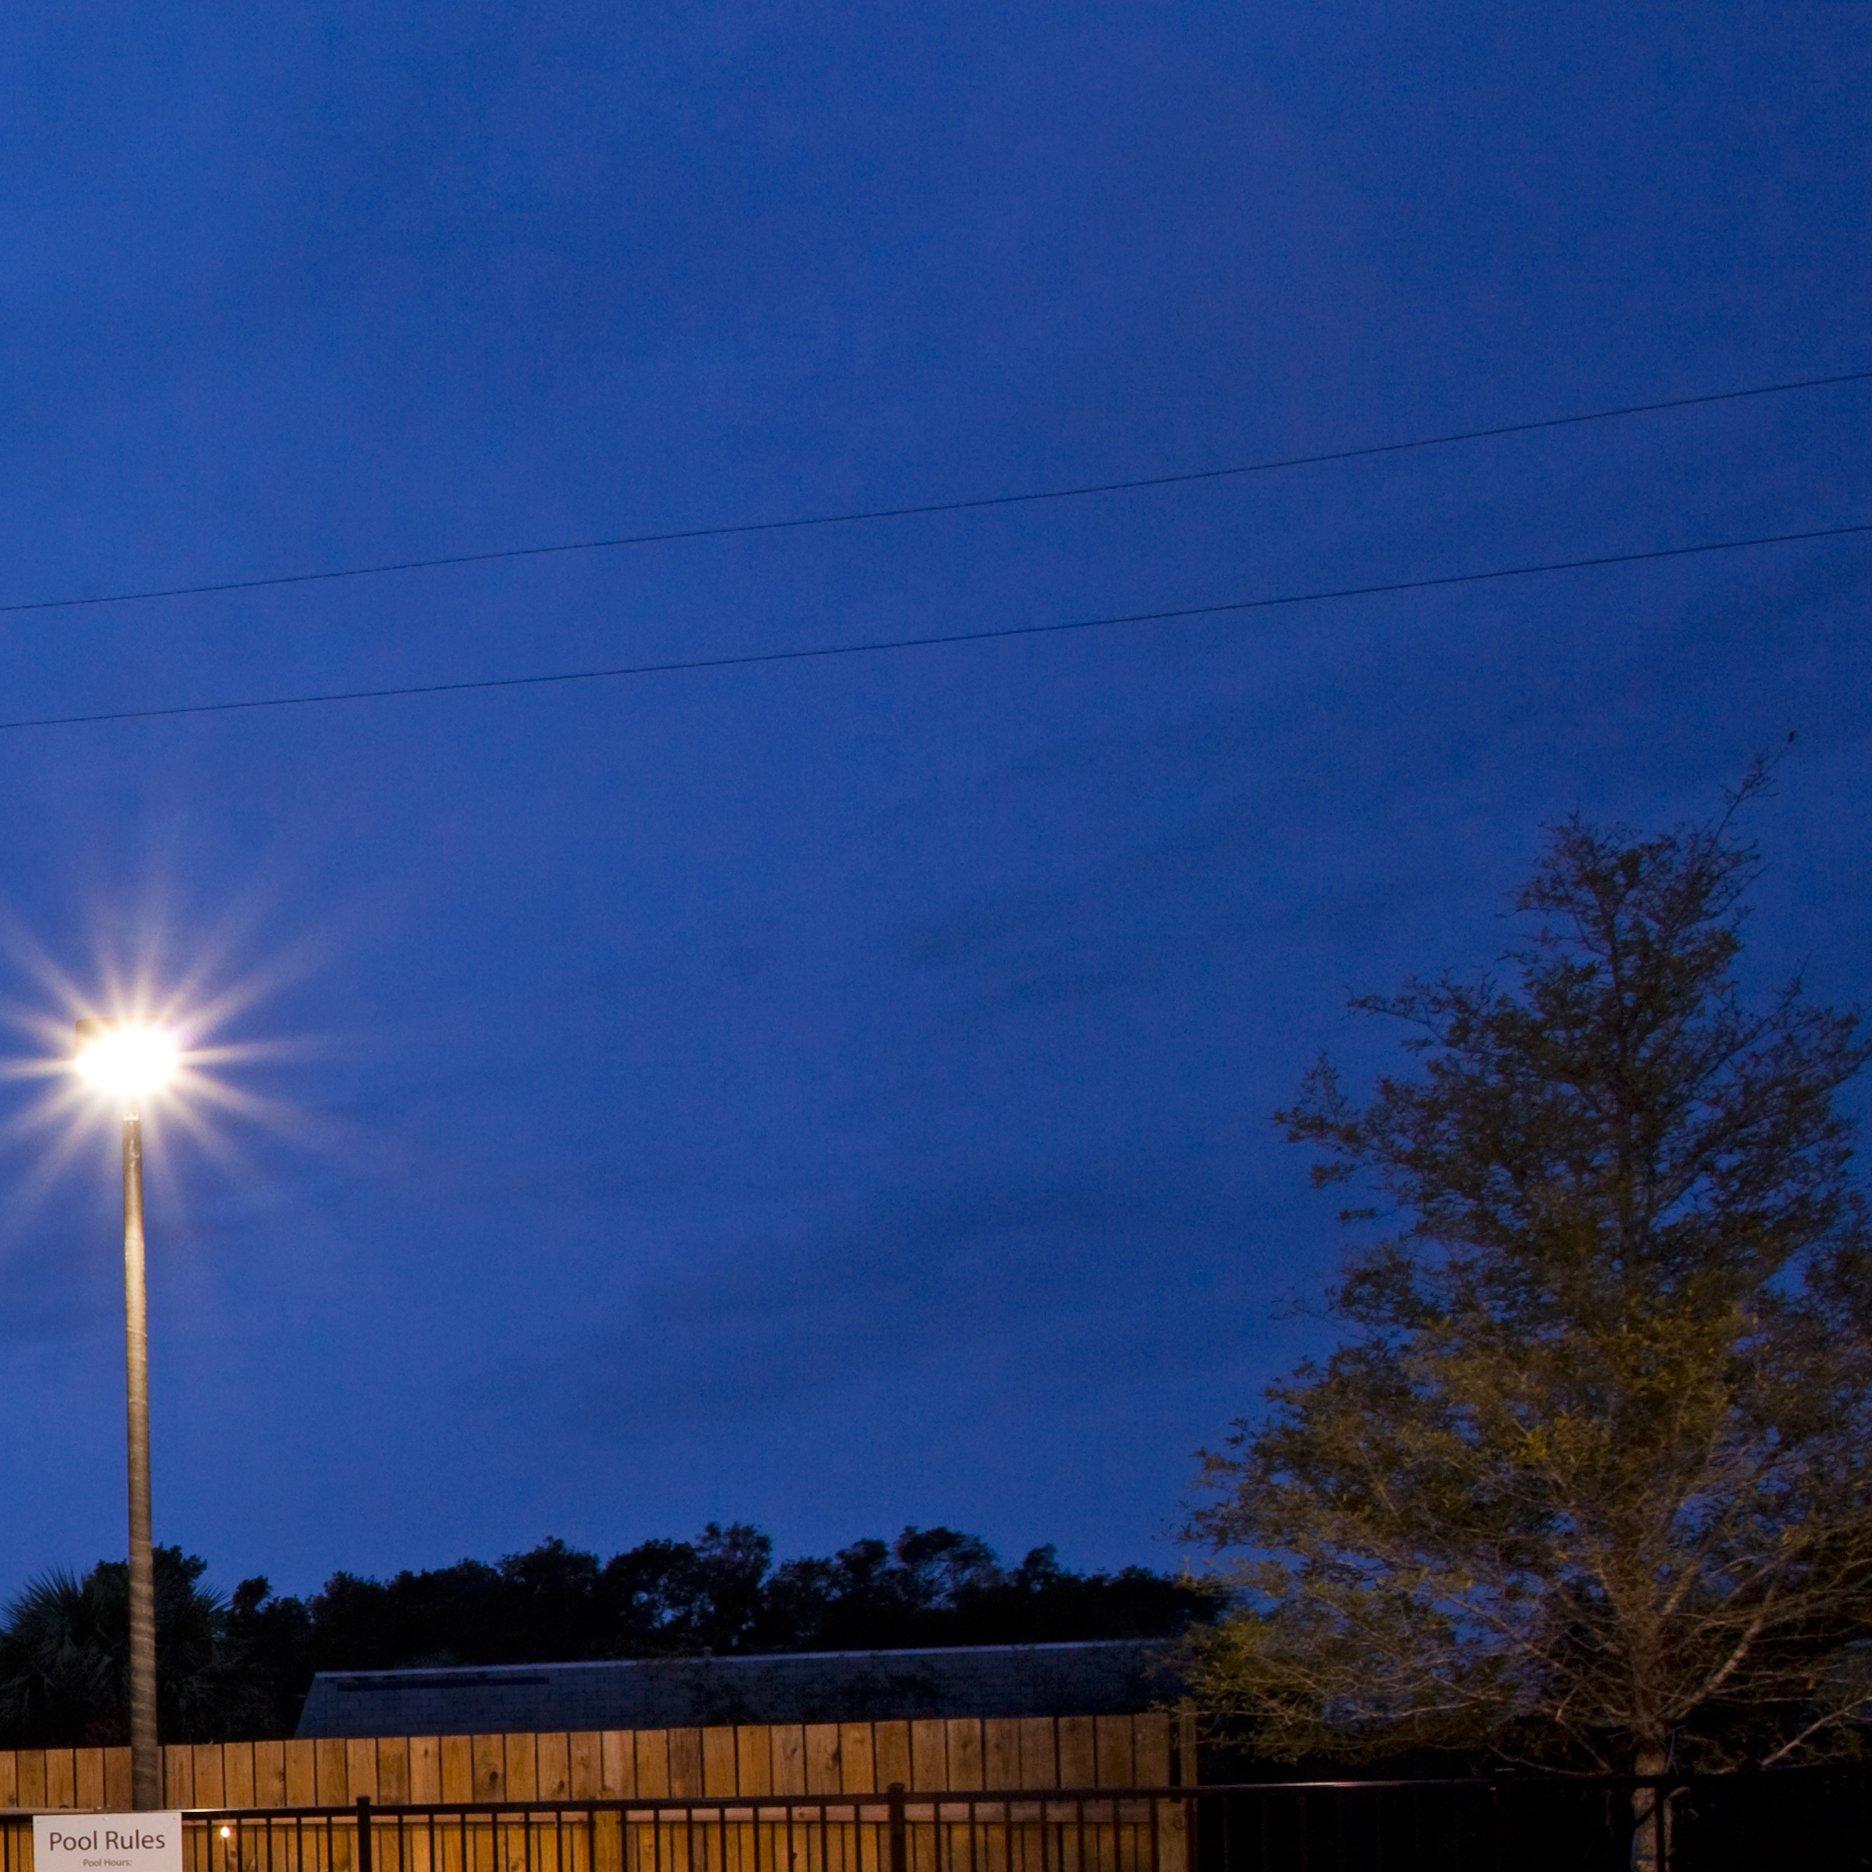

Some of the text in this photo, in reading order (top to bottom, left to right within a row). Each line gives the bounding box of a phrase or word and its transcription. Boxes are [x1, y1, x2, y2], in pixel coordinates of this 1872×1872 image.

[49, 1829, 165, 1851] Pool Rules
[83, 1858, 132, 1867] Pool Hours:
